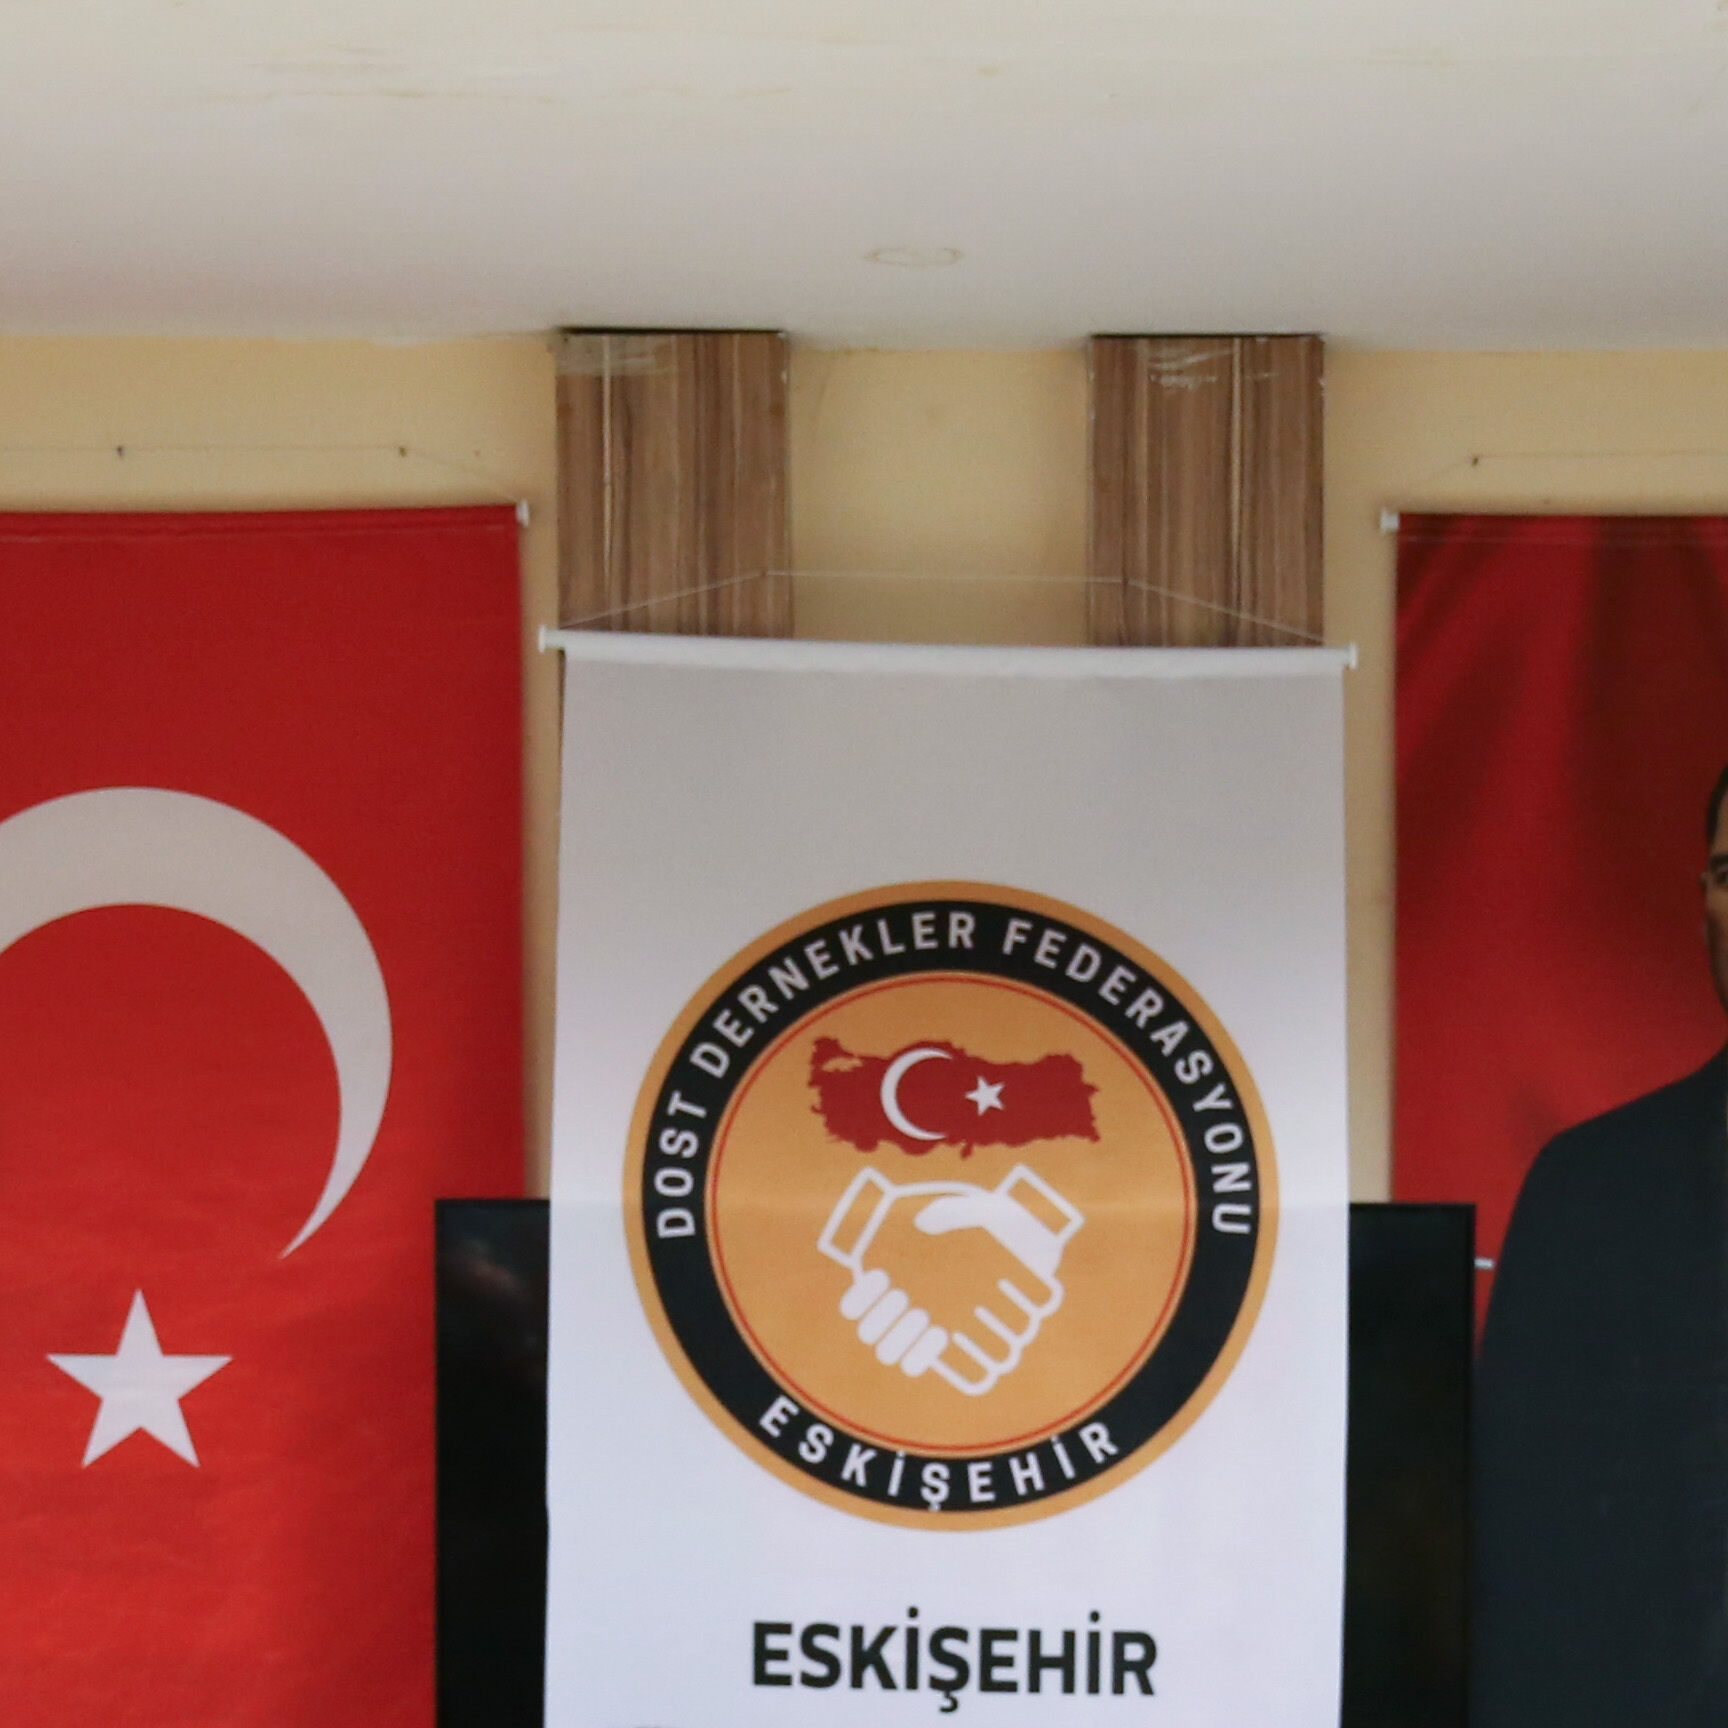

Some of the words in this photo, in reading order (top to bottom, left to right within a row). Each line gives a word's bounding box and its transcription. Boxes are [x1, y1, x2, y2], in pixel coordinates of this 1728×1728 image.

[655, 1092, 707, 1239] DOST
[692, 911, 976, 1079] DERNEKLER
[1003, 918, 1251, 1235] FEDERASYONU
[758, 1396, 1119, 1513] ESKİŞEHİR
[752, 1607, 1159, 1713] ESKİŞEHİR
